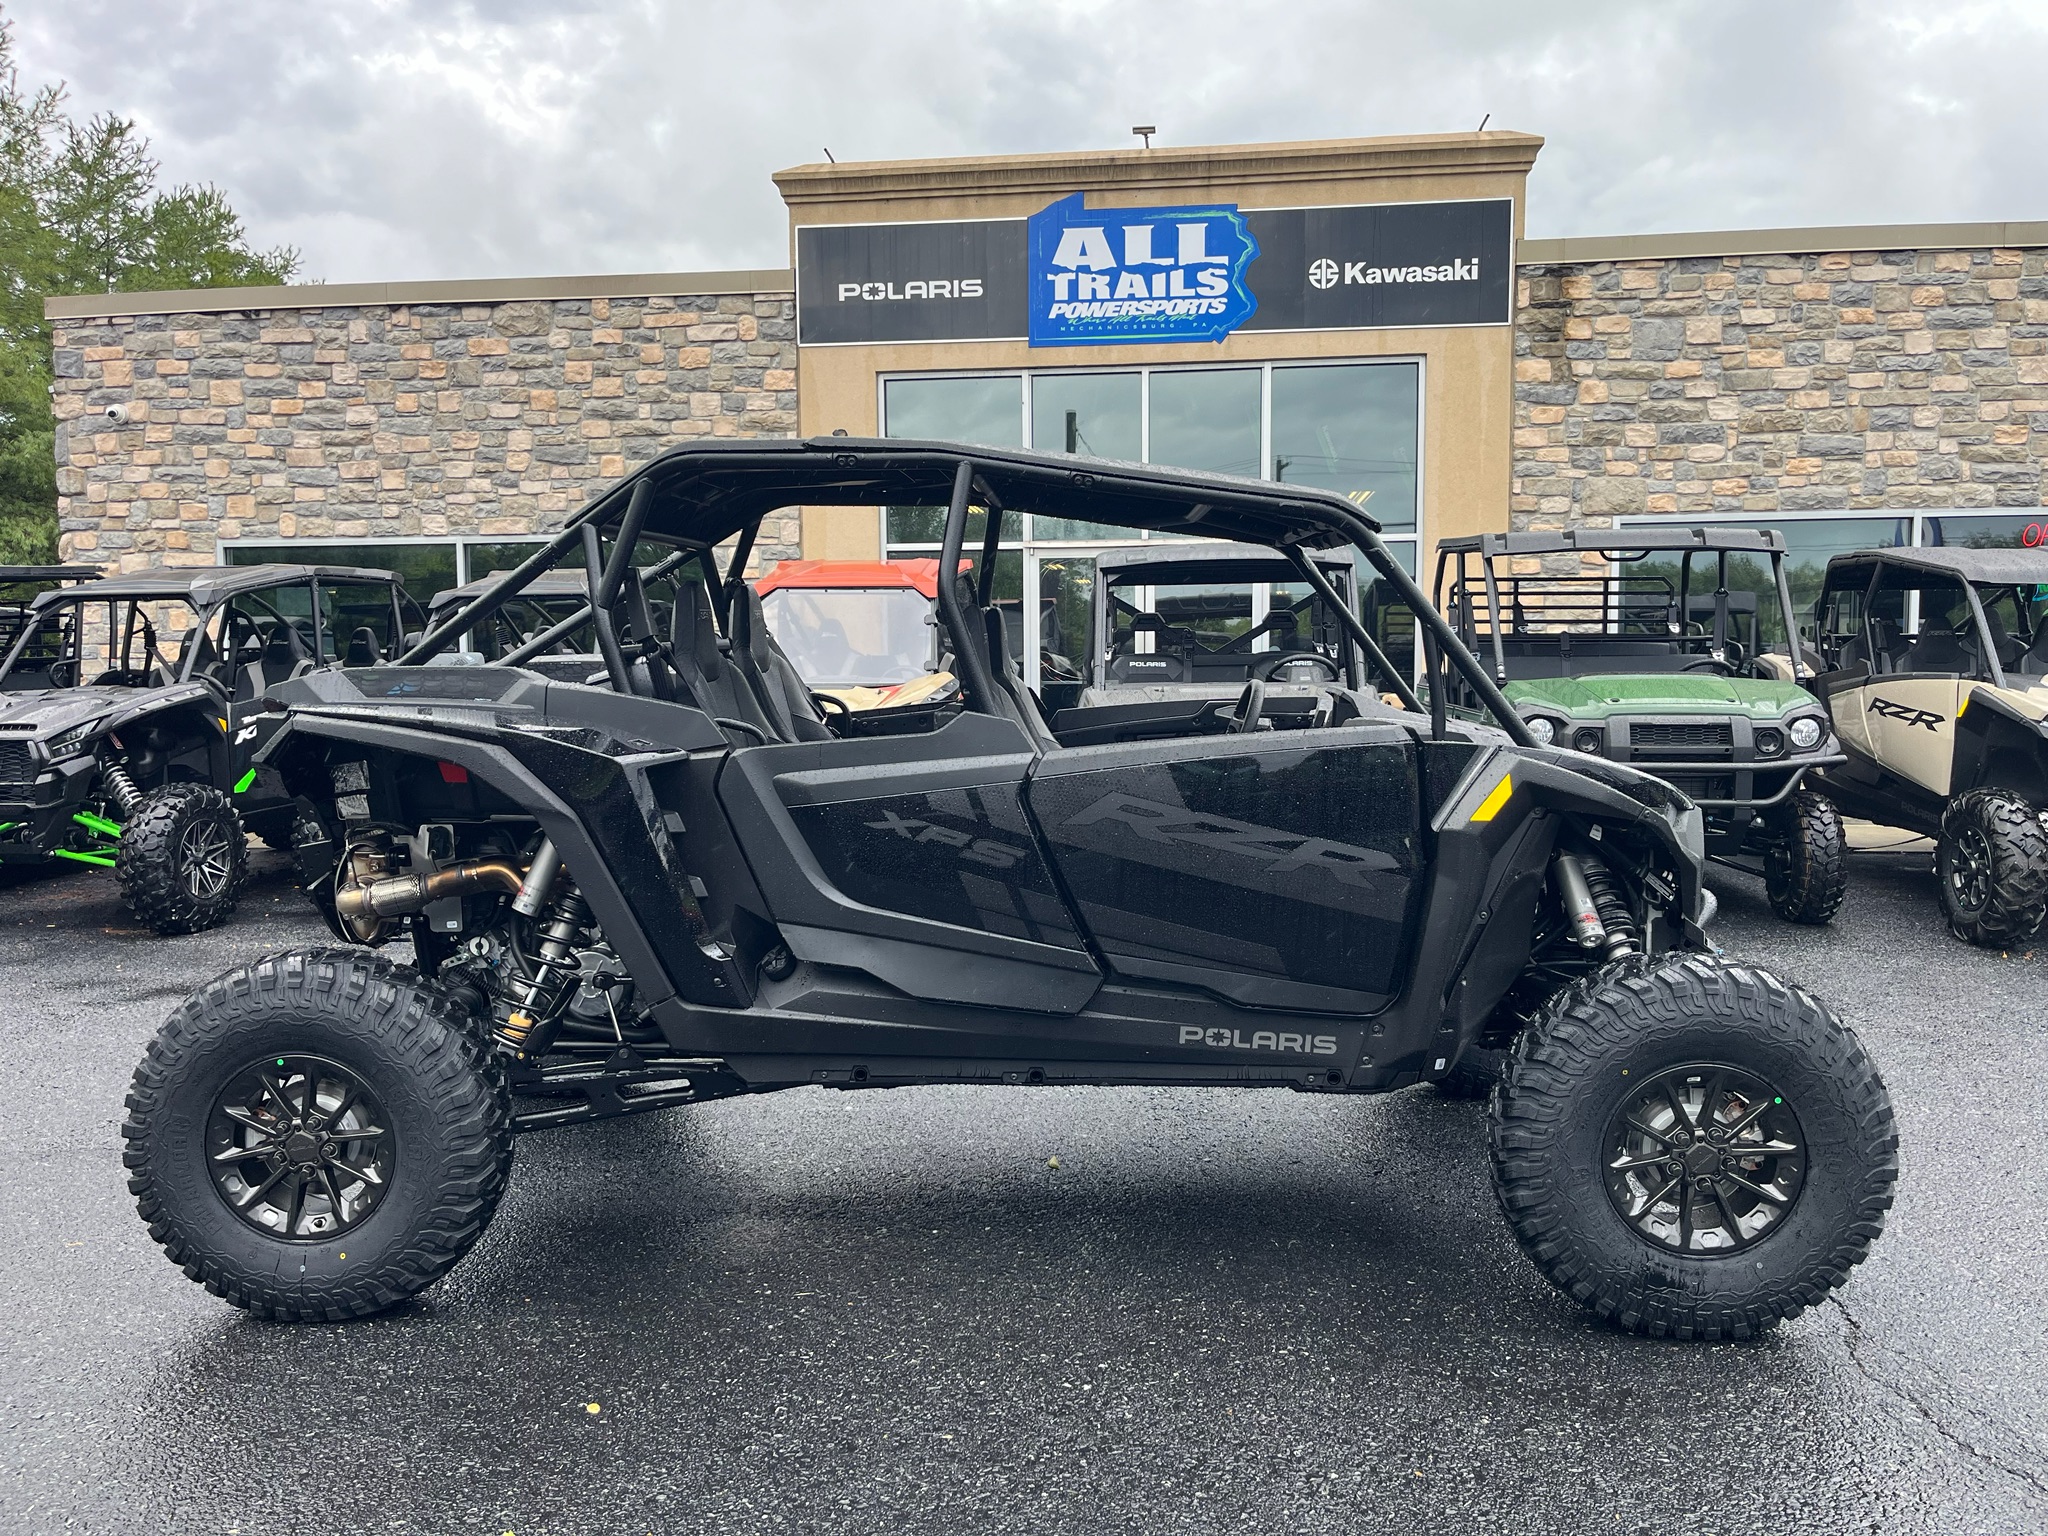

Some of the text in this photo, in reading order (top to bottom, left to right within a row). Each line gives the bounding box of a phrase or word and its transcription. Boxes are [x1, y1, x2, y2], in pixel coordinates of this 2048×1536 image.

[1052, 222, 1229, 272] ALL
[1047, 268, 1229, 301] TRAILS
[1344, 258, 1479, 284] Kawasaki
[838, 279, 984, 302] POLARIS
[1048, 297, 1228, 319] POWERSPORTS
[1129, 660, 1167, 668] POLARIS
[1867, 696, 1946, 733] RZR
[1058, 790, 1402, 891] RZR
[1178, 1026, 1338, 1055] POLARIS
